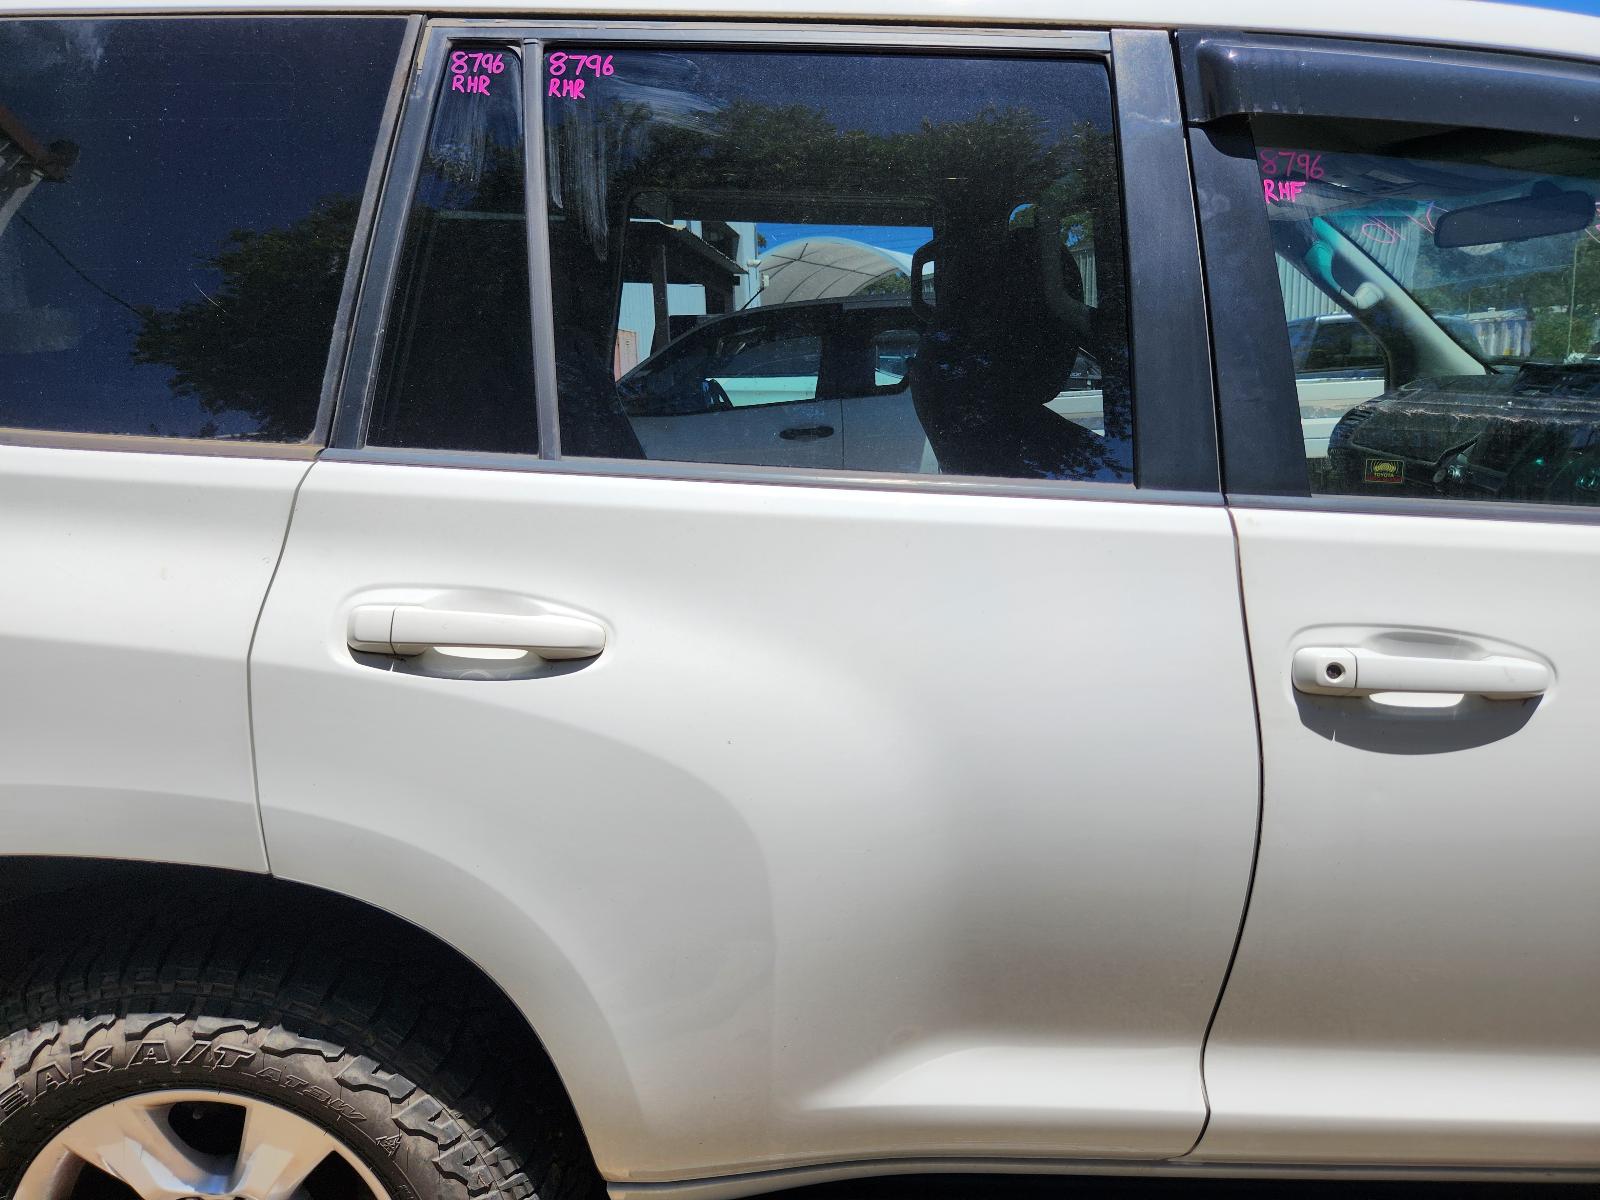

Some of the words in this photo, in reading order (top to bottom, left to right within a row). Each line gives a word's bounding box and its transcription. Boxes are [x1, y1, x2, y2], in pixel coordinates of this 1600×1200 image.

[451, 51, 505, 74] 8796
[549, 52, 615, 77] 8796
[452, 74, 490, 96] RHR
[548, 78, 586, 99] RHR
[1260, 148, 1324, 180] 8796
[1263, 179, 1306, 204] RHF
